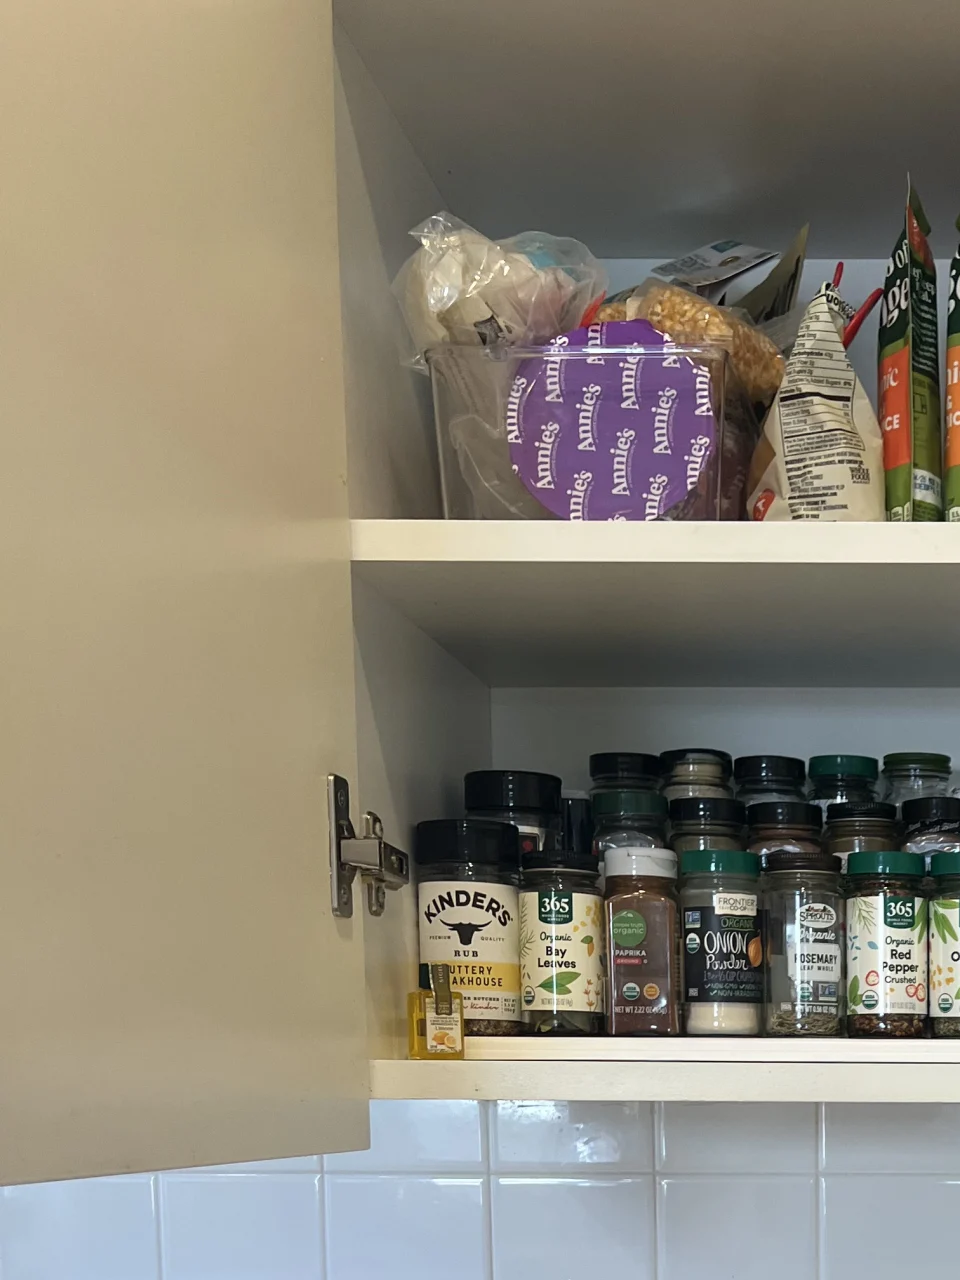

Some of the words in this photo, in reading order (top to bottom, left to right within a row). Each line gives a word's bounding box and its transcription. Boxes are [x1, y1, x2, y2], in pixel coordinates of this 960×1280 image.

[506, 375, 527, 444] Annies
[577, 383, 602, 452] Annie's
[651, 387, 677, 455] Annie's
[535, 421, 560, 490] Annie's
[610, 428, 635, 496] Annie's
[684, 435, 710, 491] nnie's
[567, 470, 592, 521] nnie's
[642, 474, 668, 521] nnie's
[424, 890, 511, 927] KINDER'S
[541, 896, 569, 913] 365
[719, 897, 755, 906] FRONTIER
[800, 911, 834, 921] SPROUTS
[887, 901, 913, 917] 365
[540, 931, 572, 943] Organic
[614, 927, 644, 935] organic
[800, 929, 835, 942] Organic
[704, 931, 748, 954] ONION
[885, 936, 915, 947] Organic
[546, 946, 567, 958] Bay
[891, 950, 911, 960] Red
[537, 958, 576, 968] Leaves
[705, 954, 748, 970] Powder
[883, 962, 919, 974] Pepper
[450, 965, 492, 975] UTTERY
[452, 977, 503, 986] AKHOUSE
[884, 976, 916, 984] Crushed
